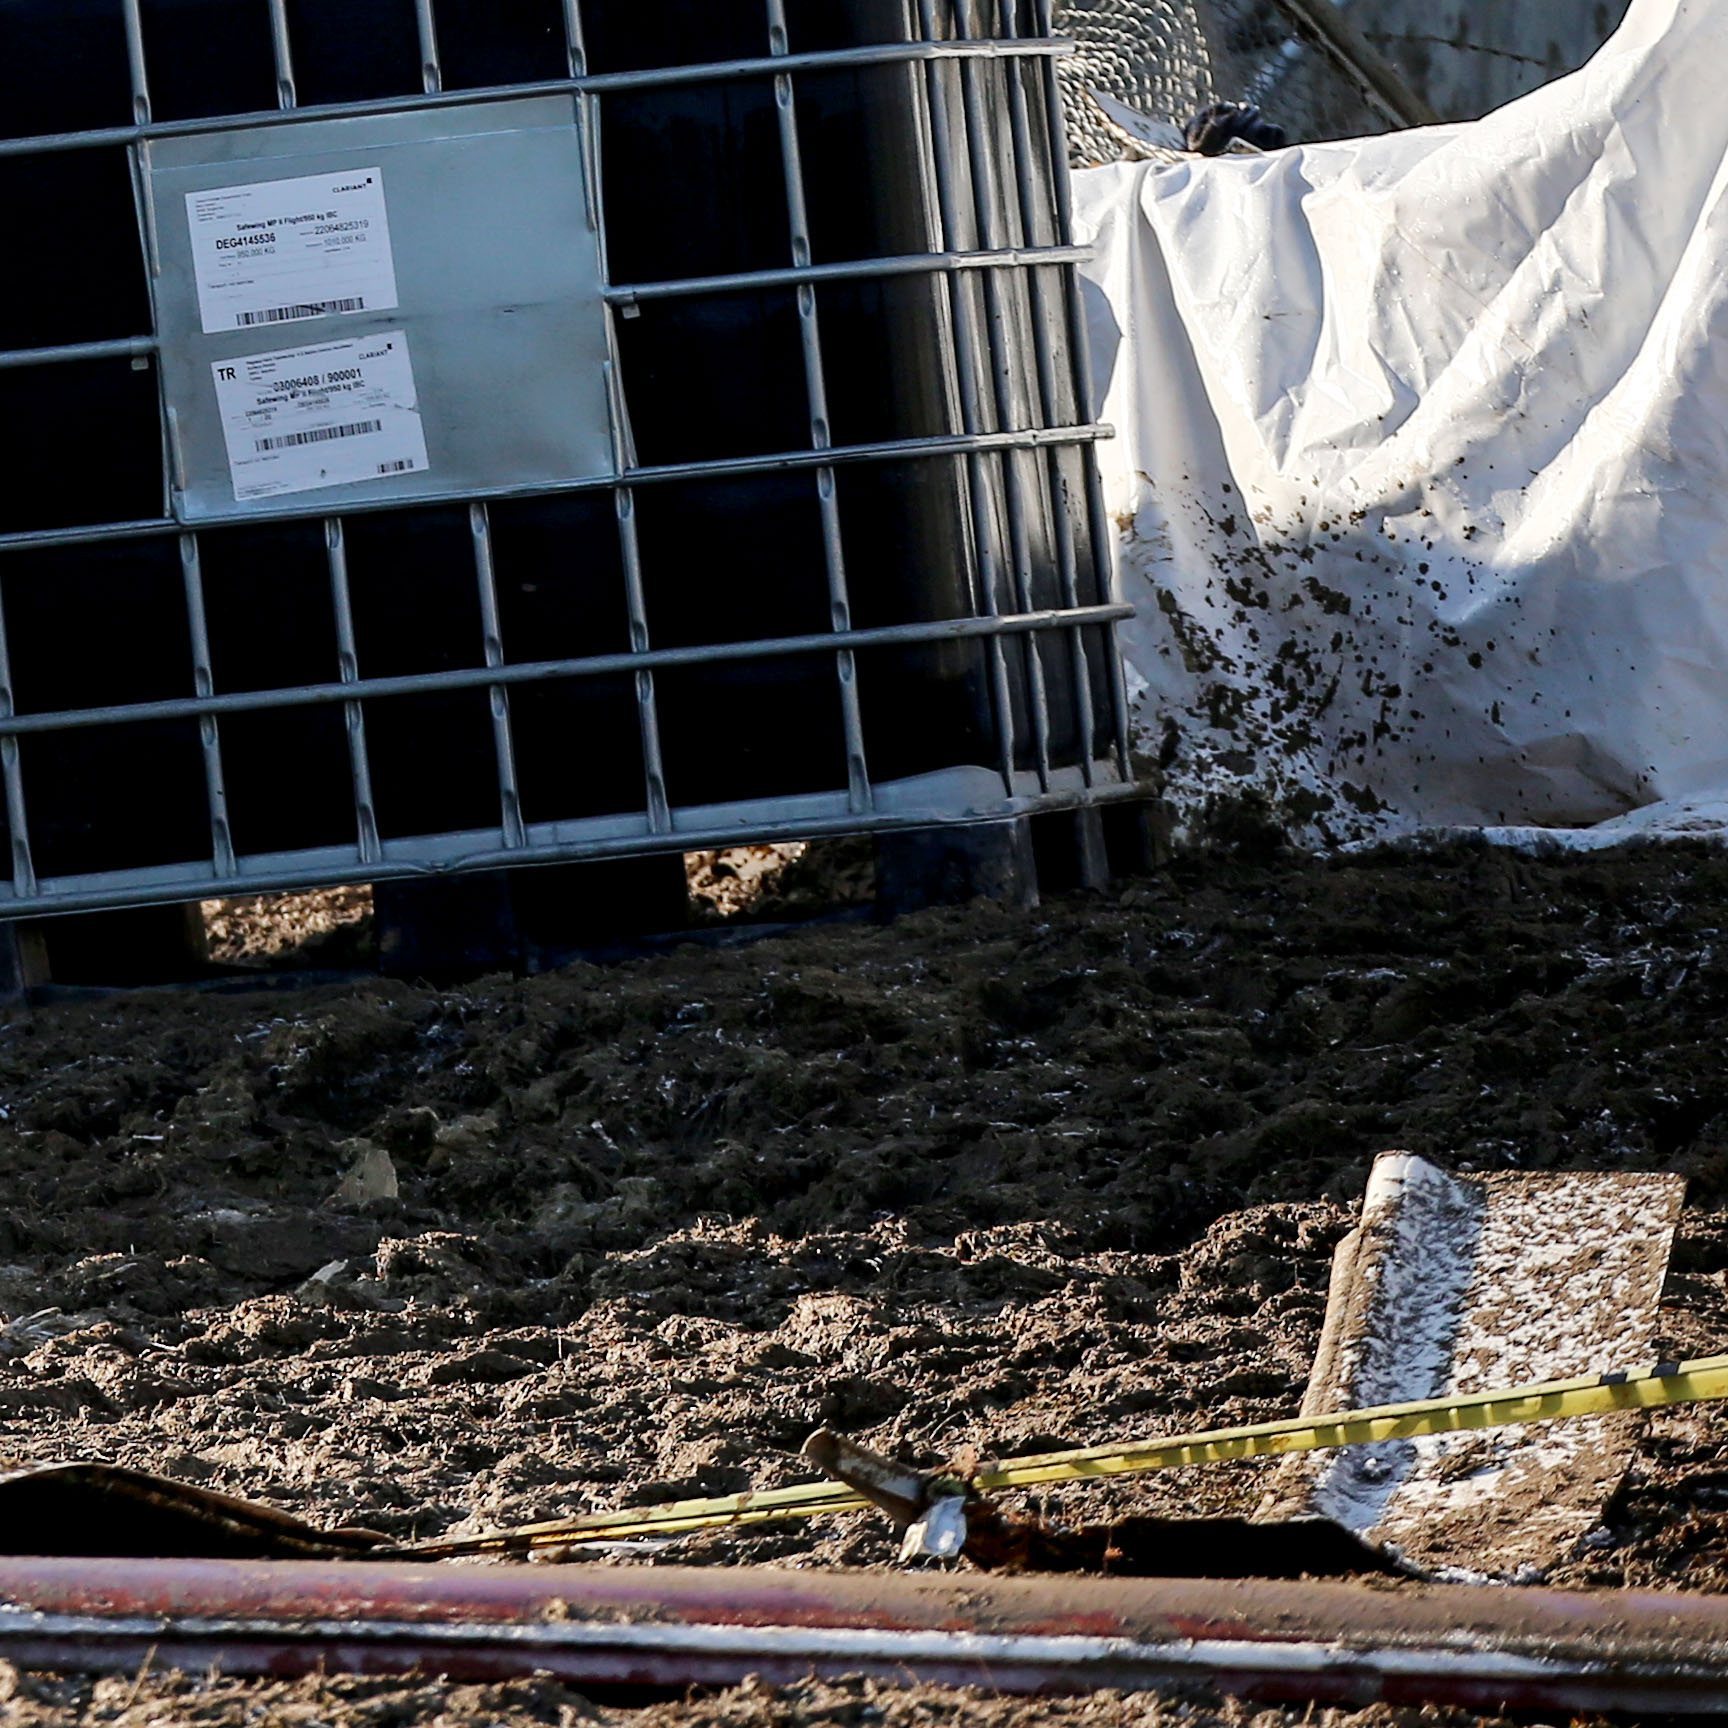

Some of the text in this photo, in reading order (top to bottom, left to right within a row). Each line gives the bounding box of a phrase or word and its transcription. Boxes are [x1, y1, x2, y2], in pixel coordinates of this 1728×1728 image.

[332, 183, 366, 193] CLARIANT
[237, 221, 266, 232] Safewing
[216, 232, 276, 250] DEG4145536
[355, 234, 366, 242] KG
[264, 247, 275, 255] KG
[359, 350, 388, 360] CLARIANT
[218, 367, 237, 381] TR
[273, 375, 320, 392] 03006408
[327, 368, 361, 383] 900001
[257, 394, 288, 406] Safewing
[343, 383, 351, 391] kg
